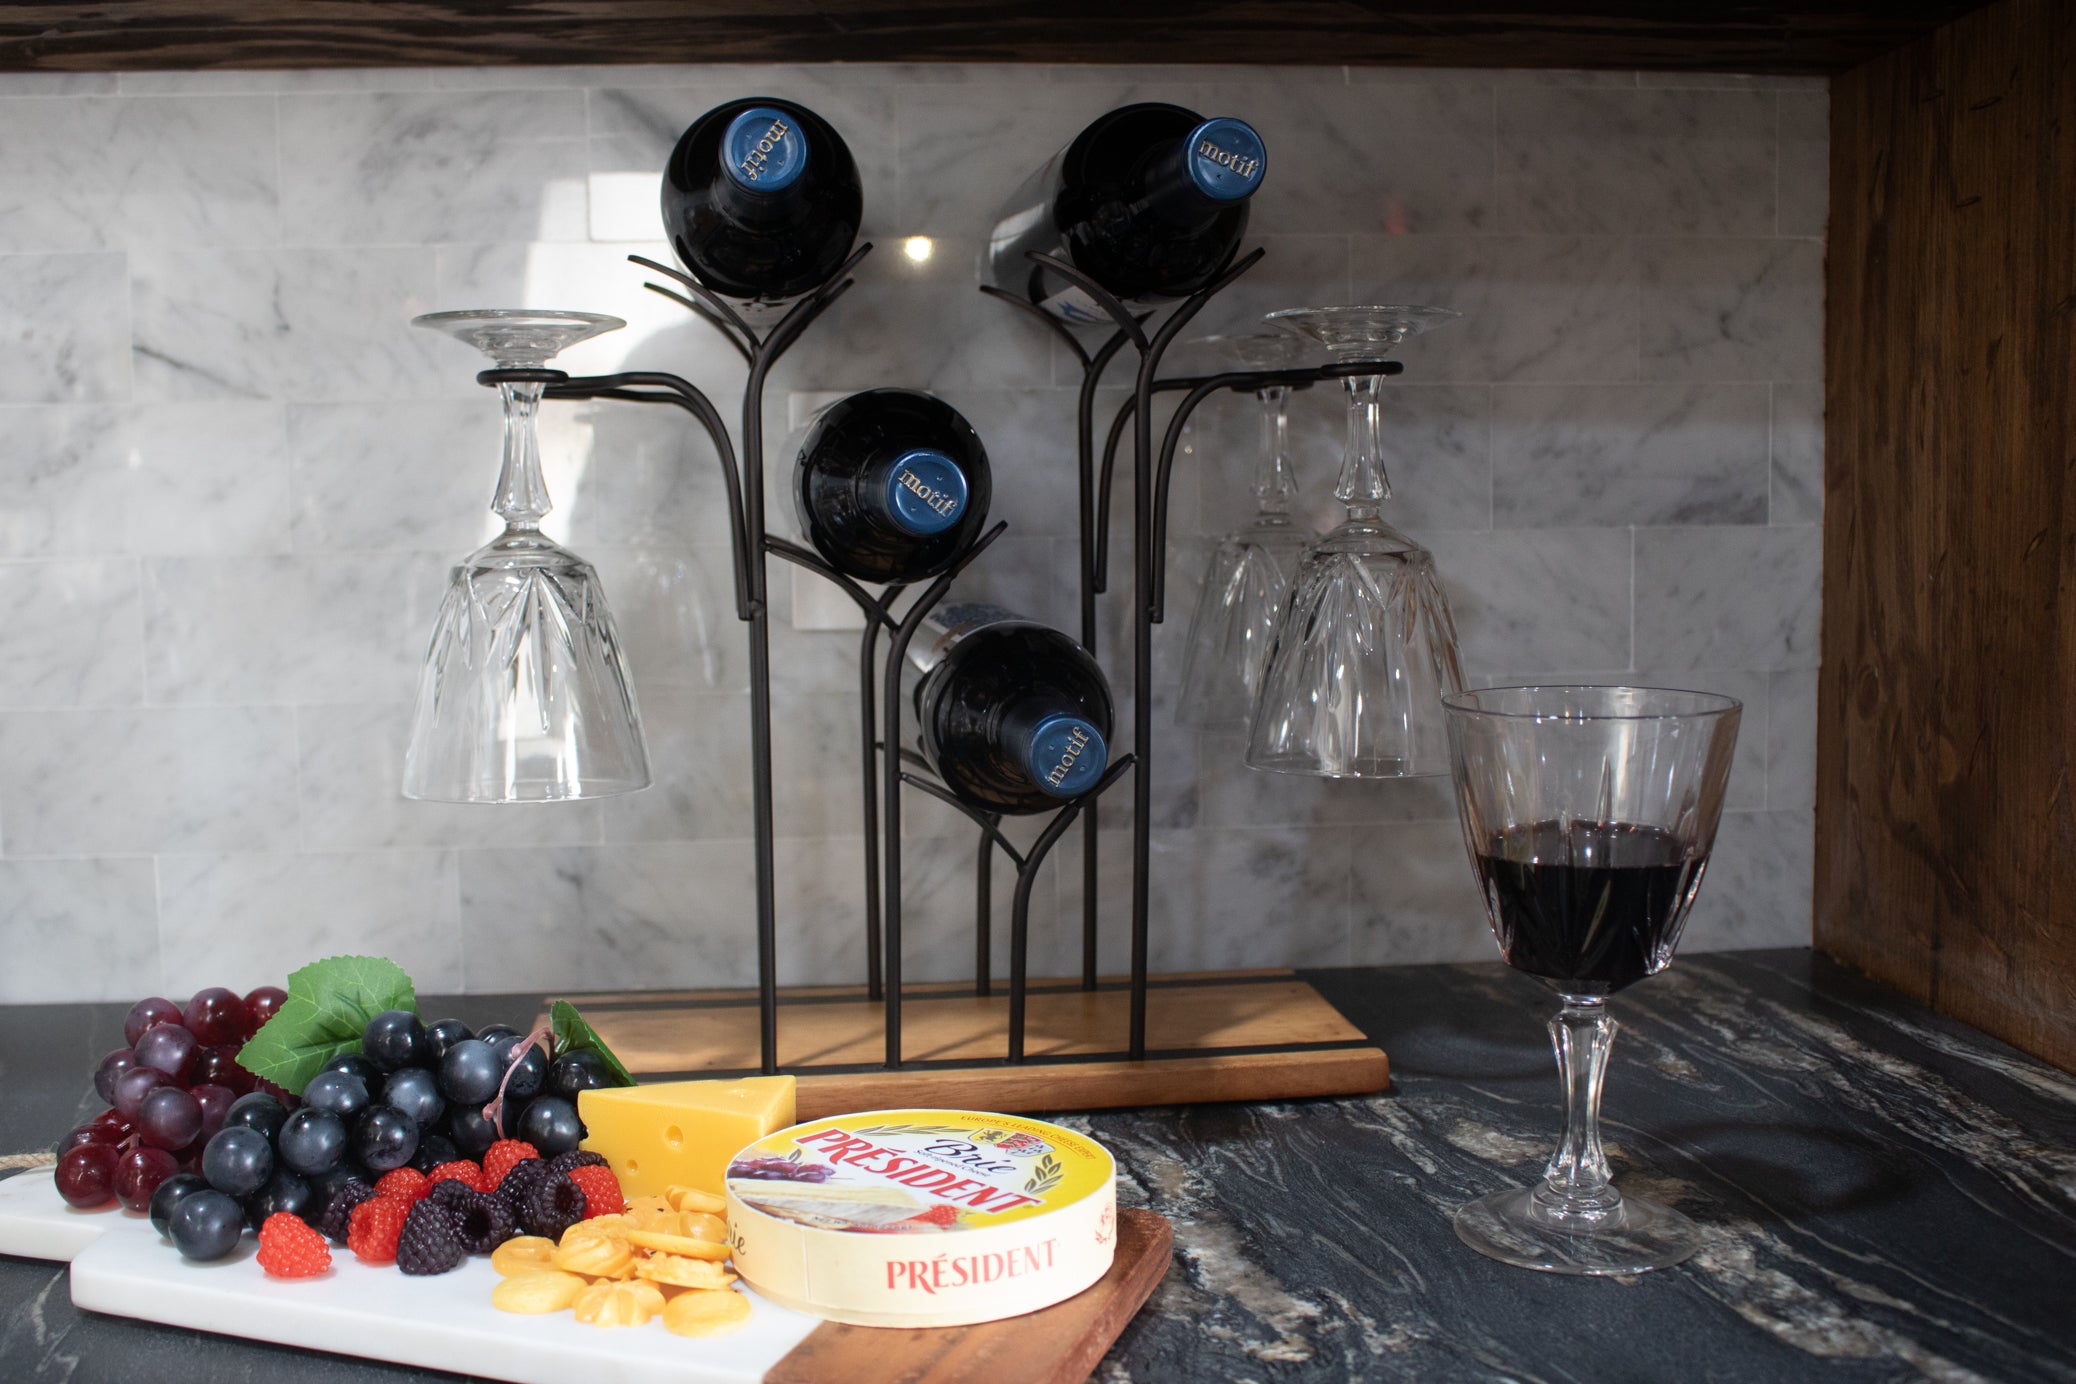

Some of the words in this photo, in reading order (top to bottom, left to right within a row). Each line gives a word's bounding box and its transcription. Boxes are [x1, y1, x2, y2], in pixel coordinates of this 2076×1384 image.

[741, 119, 788, 181] motif
[1198, 139, 1259, 179] motif
[897, 469, 958, 518] motif
[1047, 726, 1089, 787] motif
[796, 1128, 1042, 1213] PRÉSIDENT
[924, 1139, 1016, 1174] Brie
[886, 1238, 1057, 1295] PRÉSIDENT
